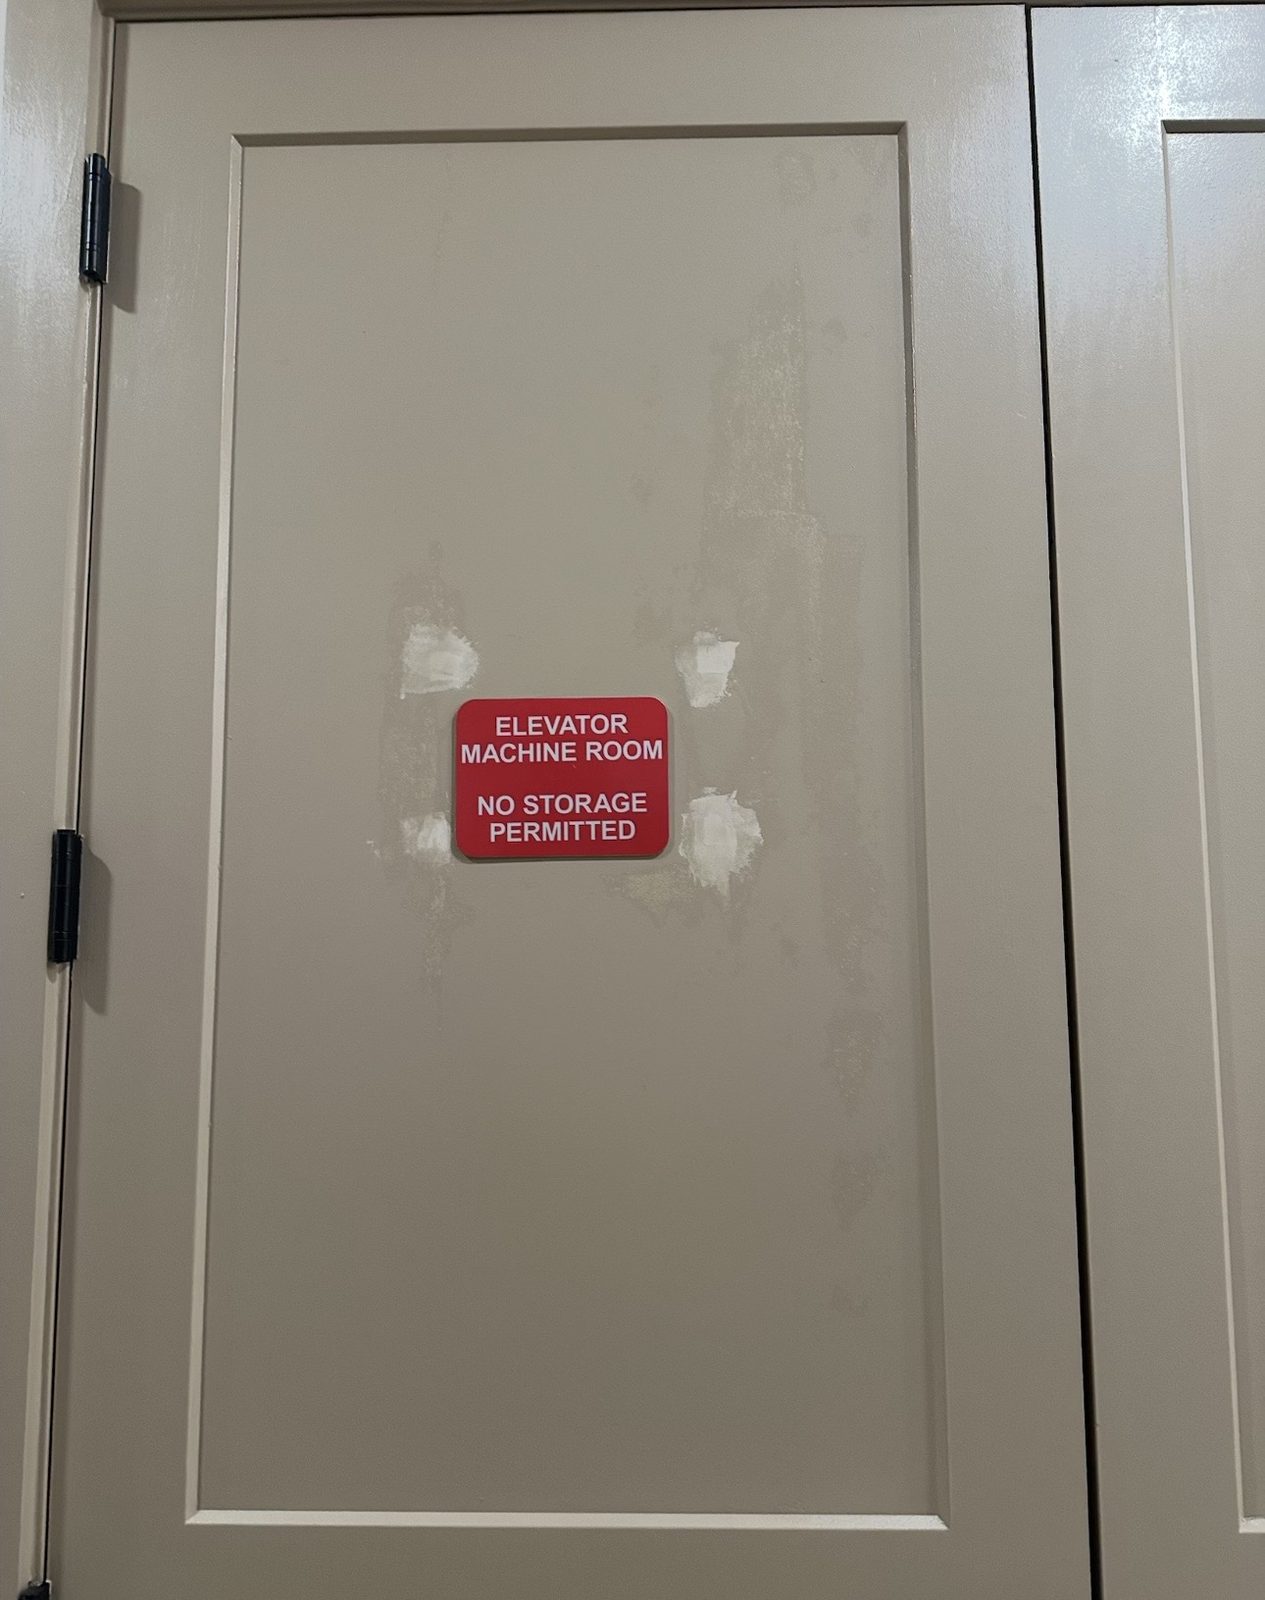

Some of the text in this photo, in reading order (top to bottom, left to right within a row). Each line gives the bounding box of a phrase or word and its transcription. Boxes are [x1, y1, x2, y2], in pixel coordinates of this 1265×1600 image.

[496, 714, 629, 737] ELEVATOR
[461, 740, 663, 764] MACHINE ROOM
[478, 793, 647, 816] NO STORAGE
[490, 820, 636, 843] PERMITTED
